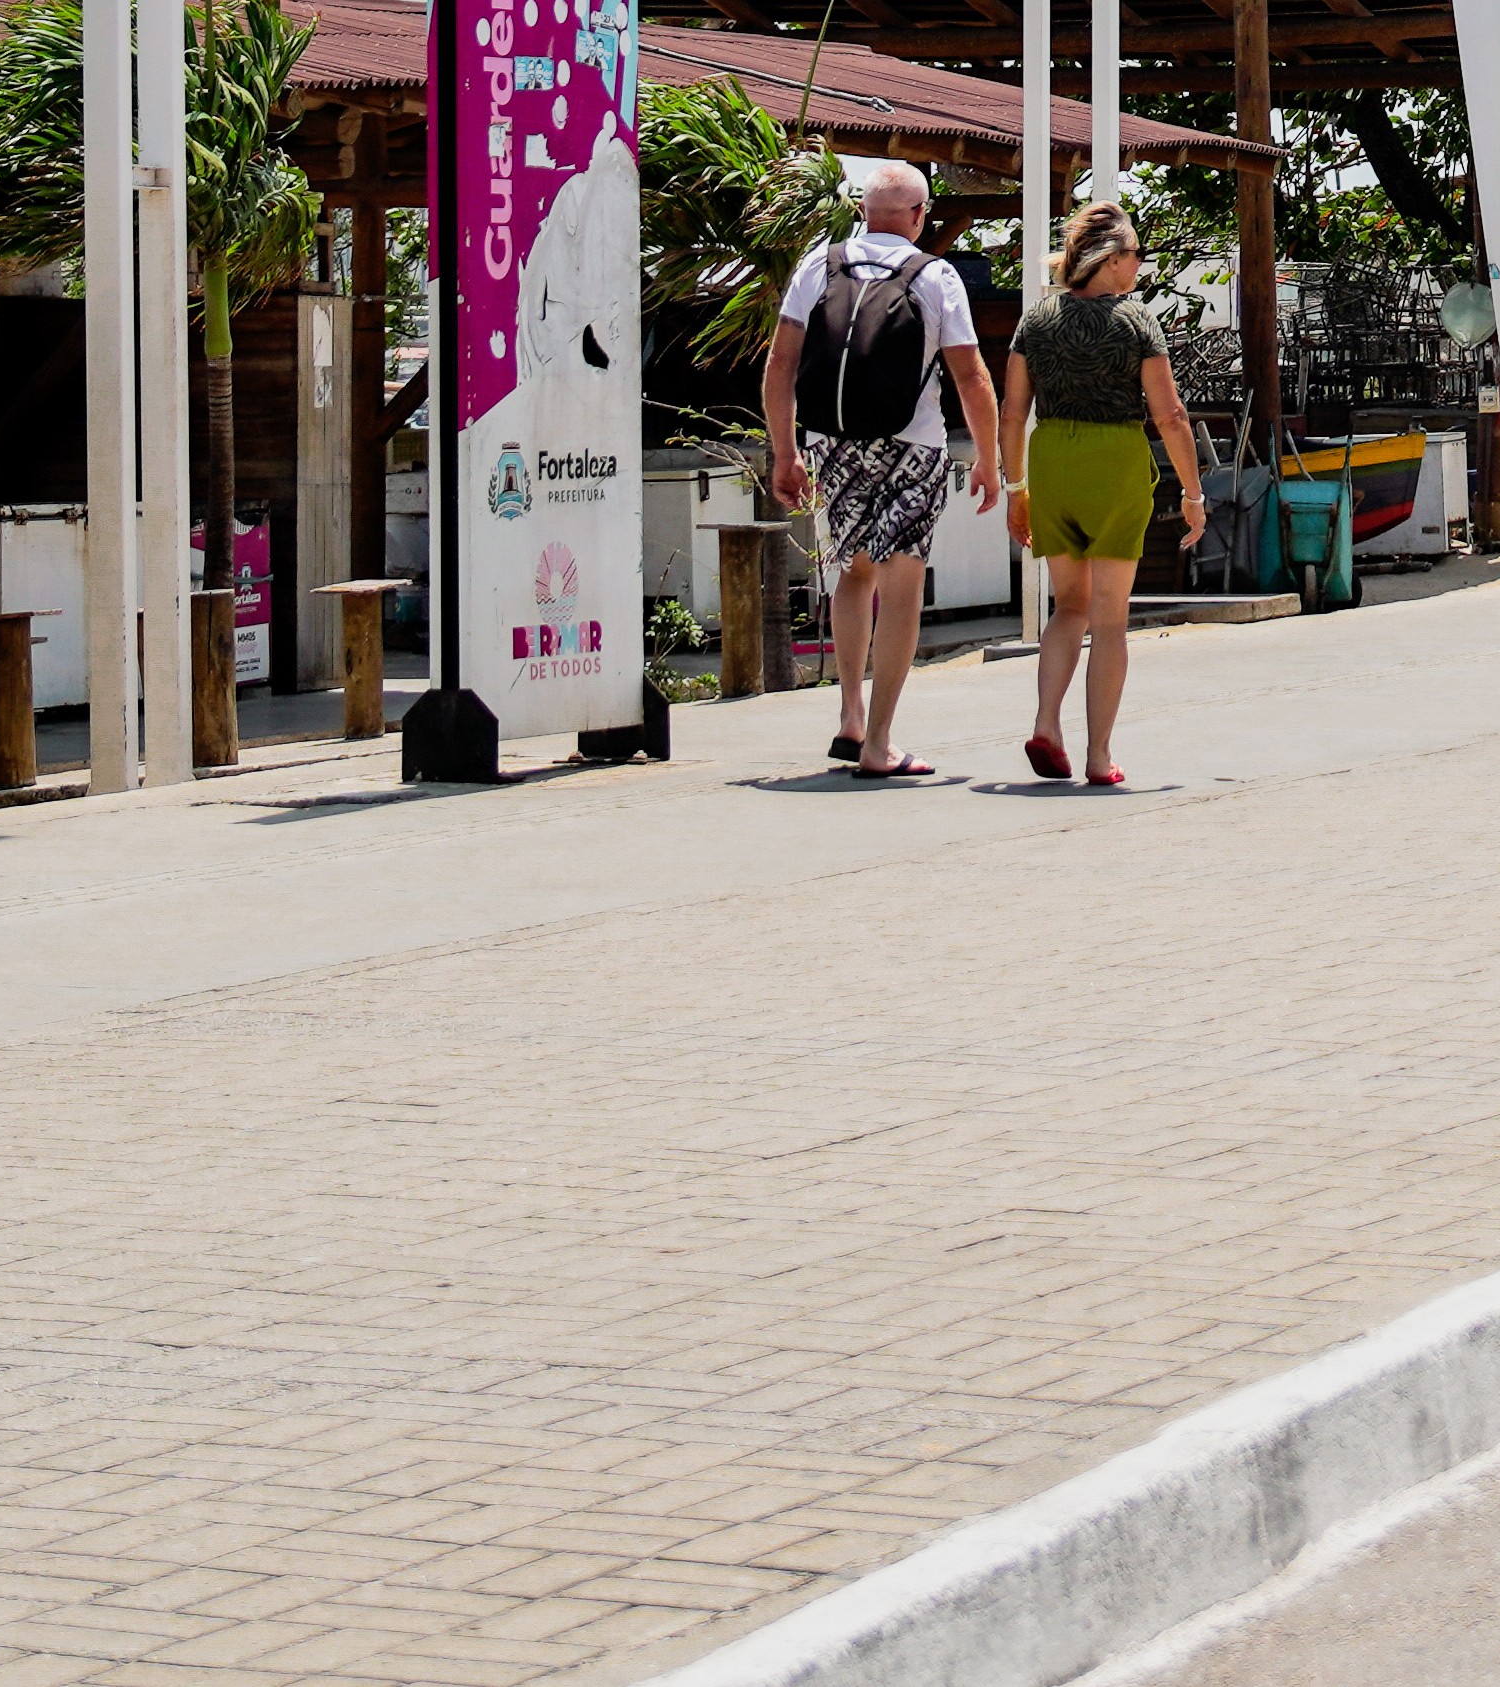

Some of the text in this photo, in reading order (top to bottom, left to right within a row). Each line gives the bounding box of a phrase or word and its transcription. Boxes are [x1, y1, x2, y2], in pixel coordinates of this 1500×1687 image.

[538, 447, 617, 481] Fortaleza
[548, 488, 606, 504] PREFEITURA
[234, 590, 262, 606] ortaleza
[530, 656, 602, 681] DE TODOS
